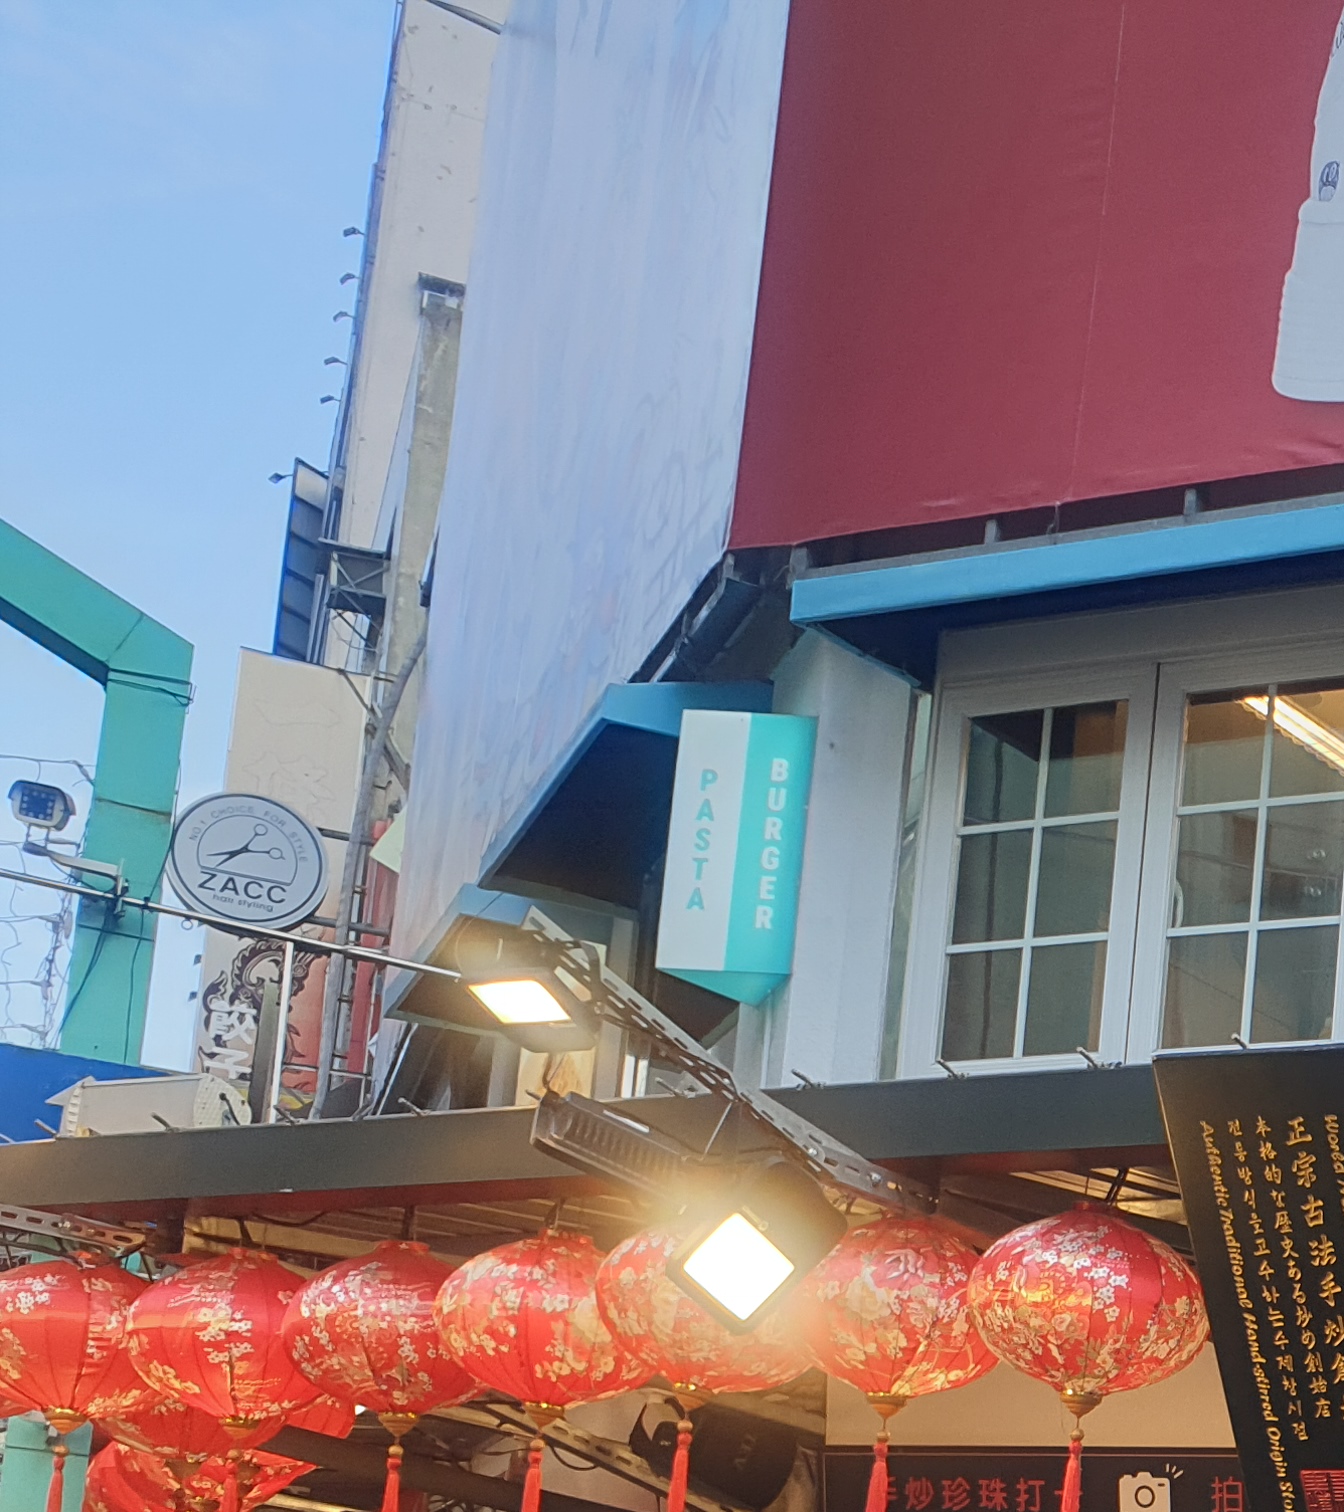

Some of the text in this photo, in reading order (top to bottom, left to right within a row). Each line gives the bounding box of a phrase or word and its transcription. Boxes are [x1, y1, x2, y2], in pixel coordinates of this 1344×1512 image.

[210, 805, 254, 819] CHOICE
[263, 810, 287, 828] FOR
[289, 831, 309, 863] STYLE
[686, 768, 719, 911] PASTA
[755, 757, 790, 930] BURGER
[198, 870, 287, 904] ZACC
[212, 893, 274, 913] hair styling
[208, 998, 258, 1080] 餃子
[1199, 1119, 1229, 1208] Authentic
[1218, 1207, 1254, 1310] Traditional
[1265, 1425, 1287, 1479] Origin
[880, 1476, 1083, 1512] 炒珍珠打
